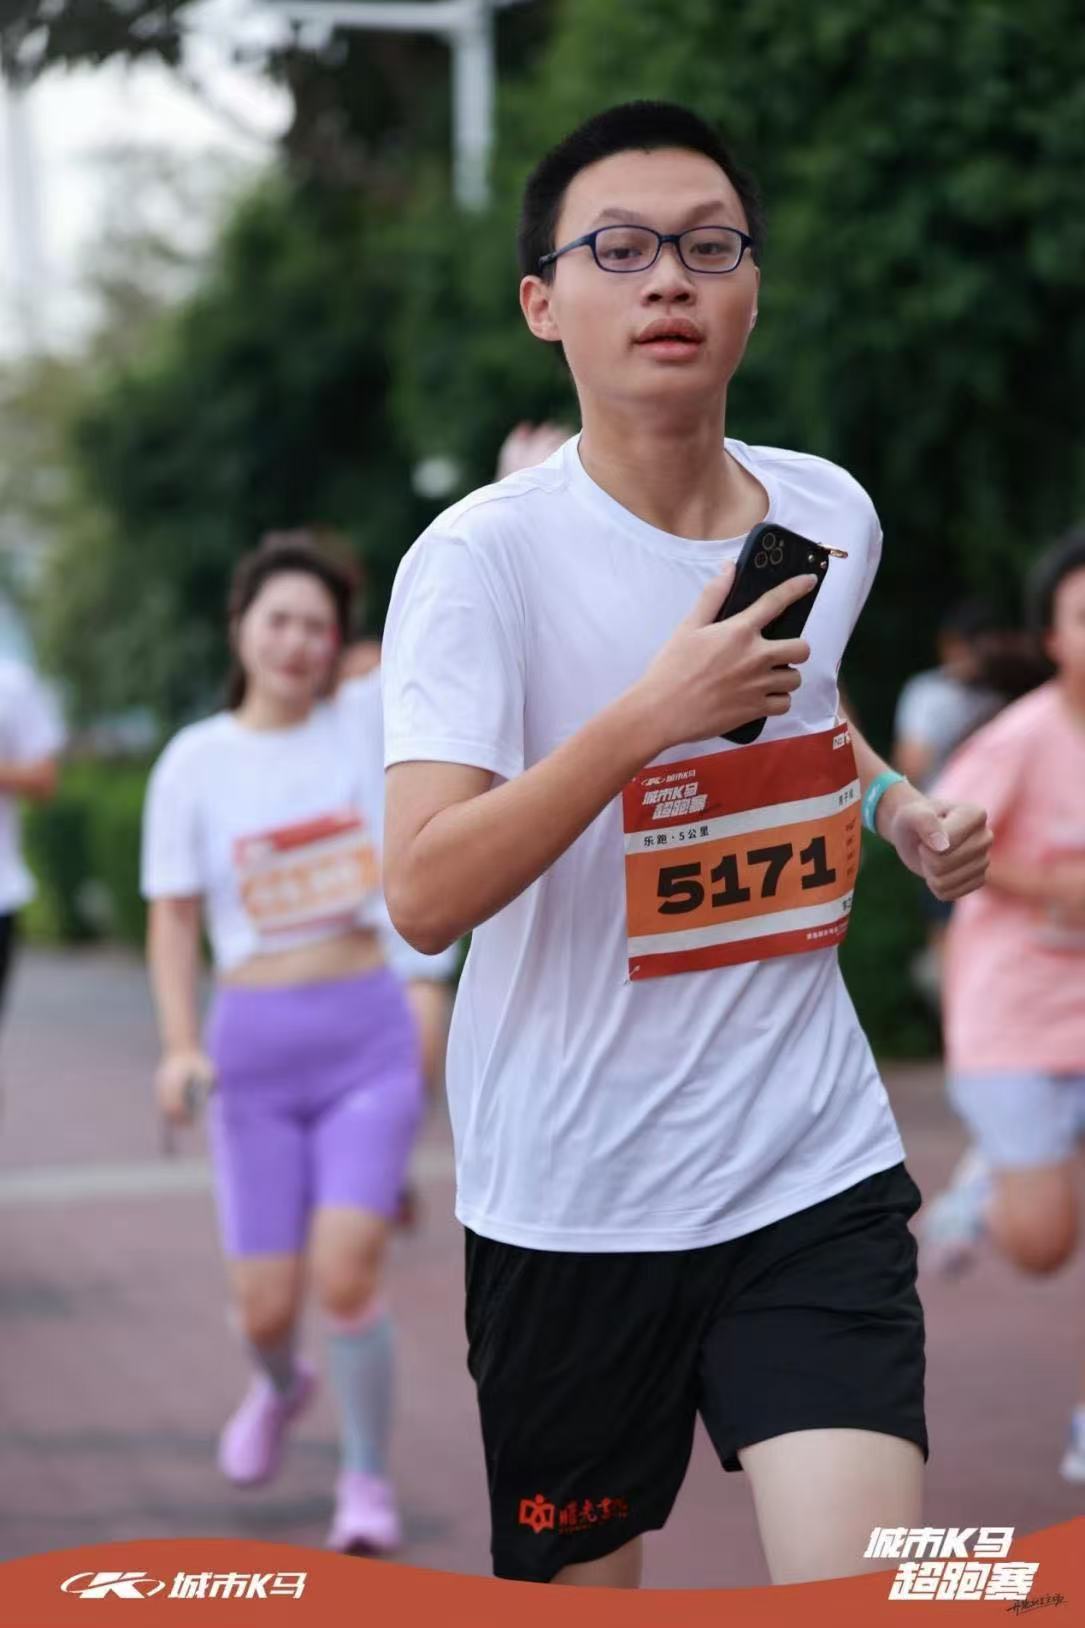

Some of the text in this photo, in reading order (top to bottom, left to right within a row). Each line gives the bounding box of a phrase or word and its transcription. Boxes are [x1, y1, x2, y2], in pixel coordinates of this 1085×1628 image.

[642, 782, 698, 805] 城市K马
[657, 836, 837, 915] 5171
